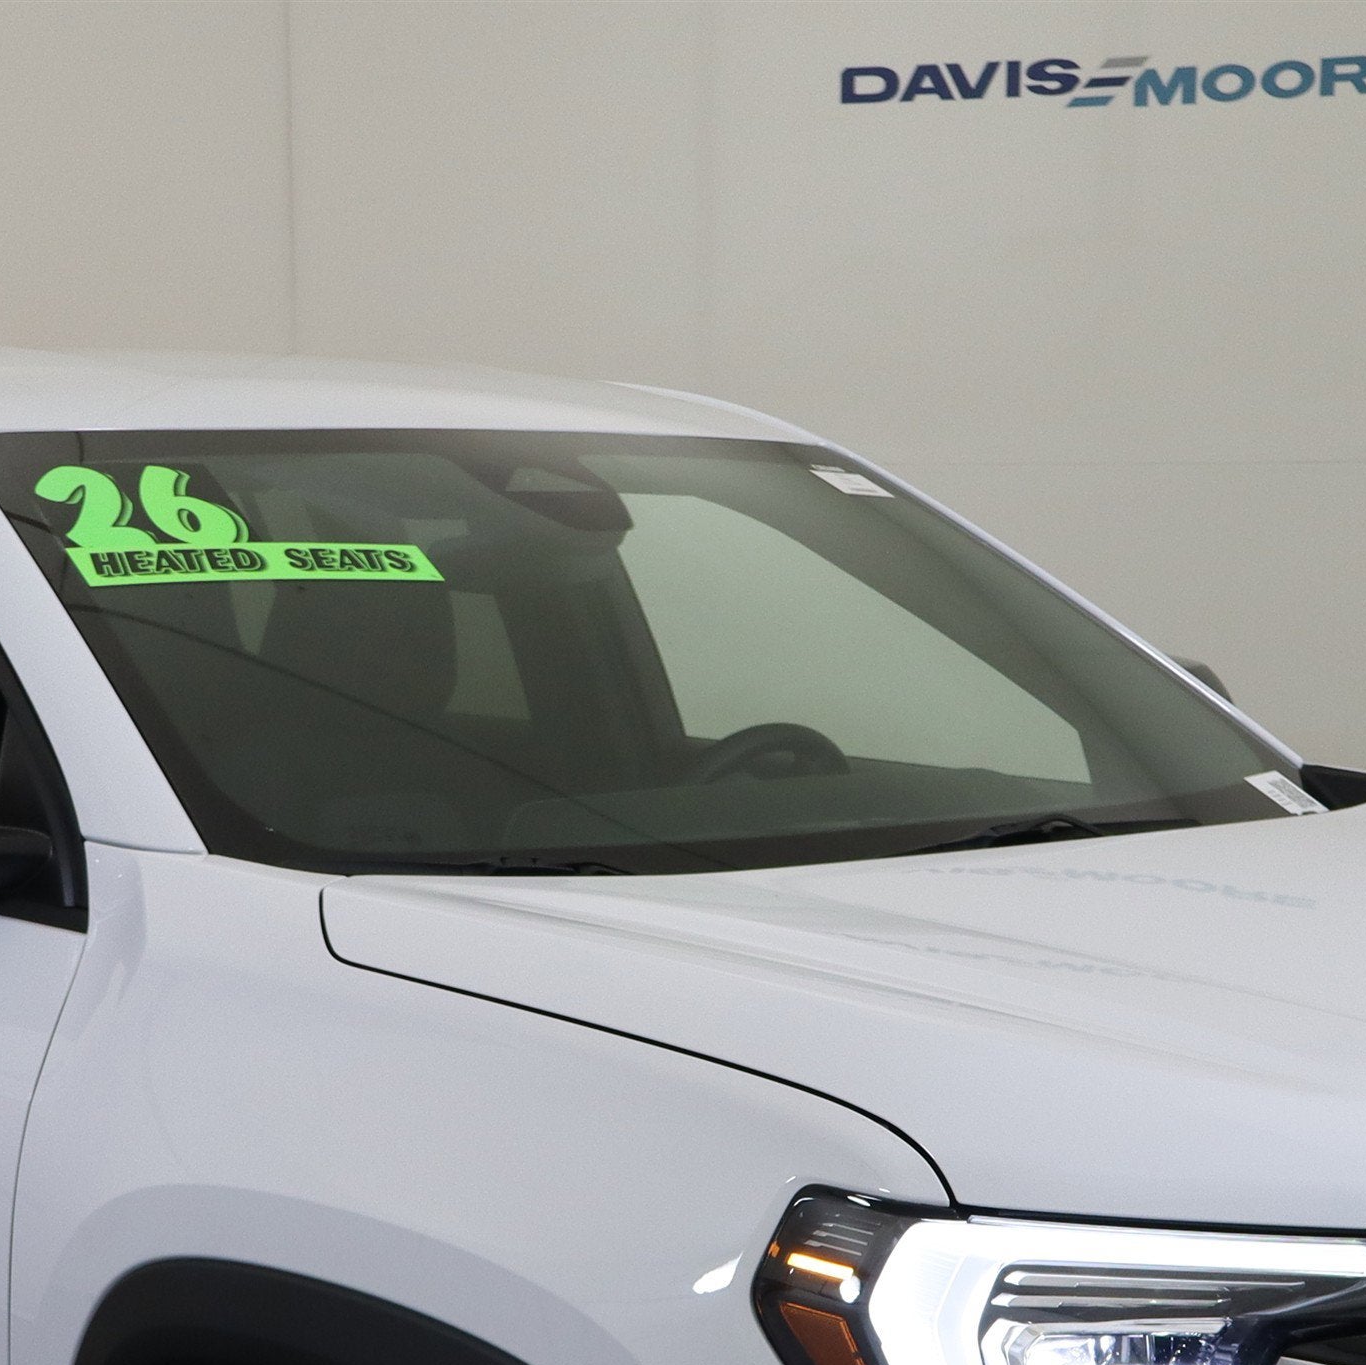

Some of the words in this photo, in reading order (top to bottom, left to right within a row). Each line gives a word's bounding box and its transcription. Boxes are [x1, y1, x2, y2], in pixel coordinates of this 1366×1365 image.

[840, 58, 1081, 104] DAVIS
[35, 465, 250, 547] 26
[89, 547, 266, 577] HEATED
[285, 547, 418, 573] SEATS
